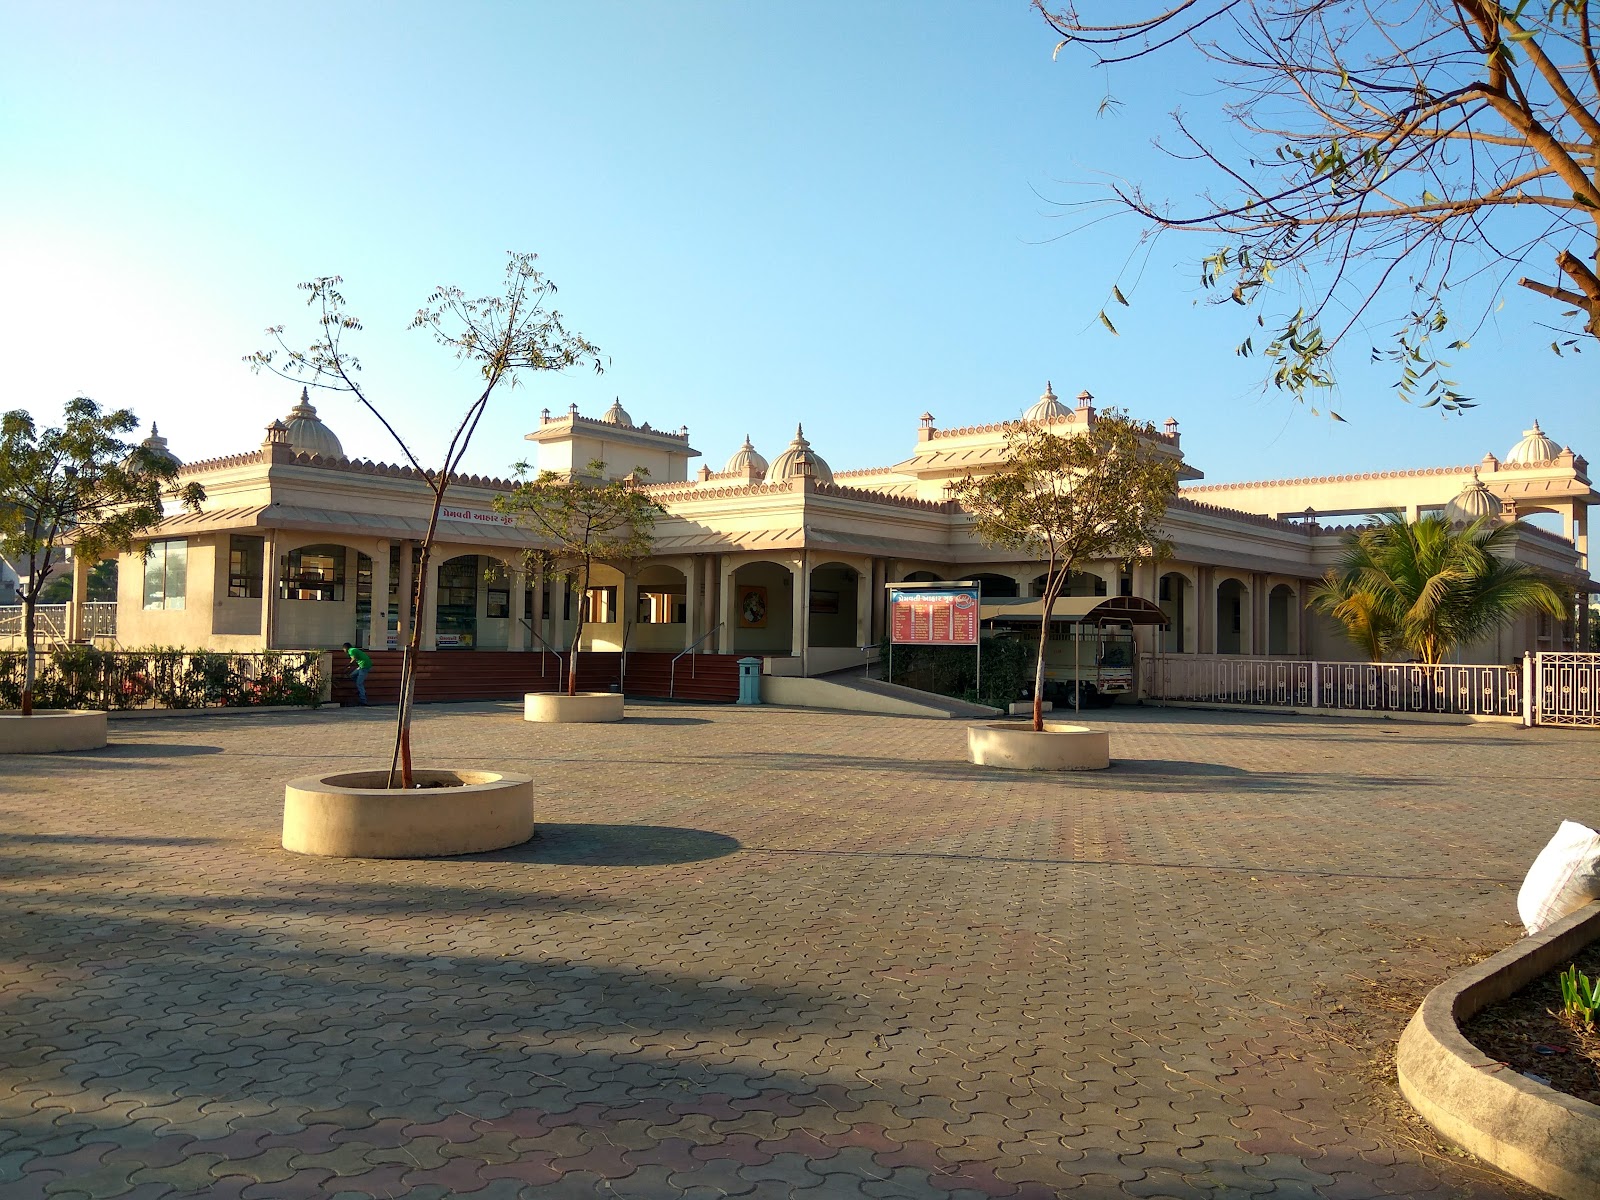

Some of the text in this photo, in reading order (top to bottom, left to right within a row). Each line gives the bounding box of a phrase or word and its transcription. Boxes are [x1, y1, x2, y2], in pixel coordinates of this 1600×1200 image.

[443, 508, 471, 519] પ્રેમવતી
[473, 513, 498, 522] આહાર
[898, 594, 921, 602] પ્રેમવતી
